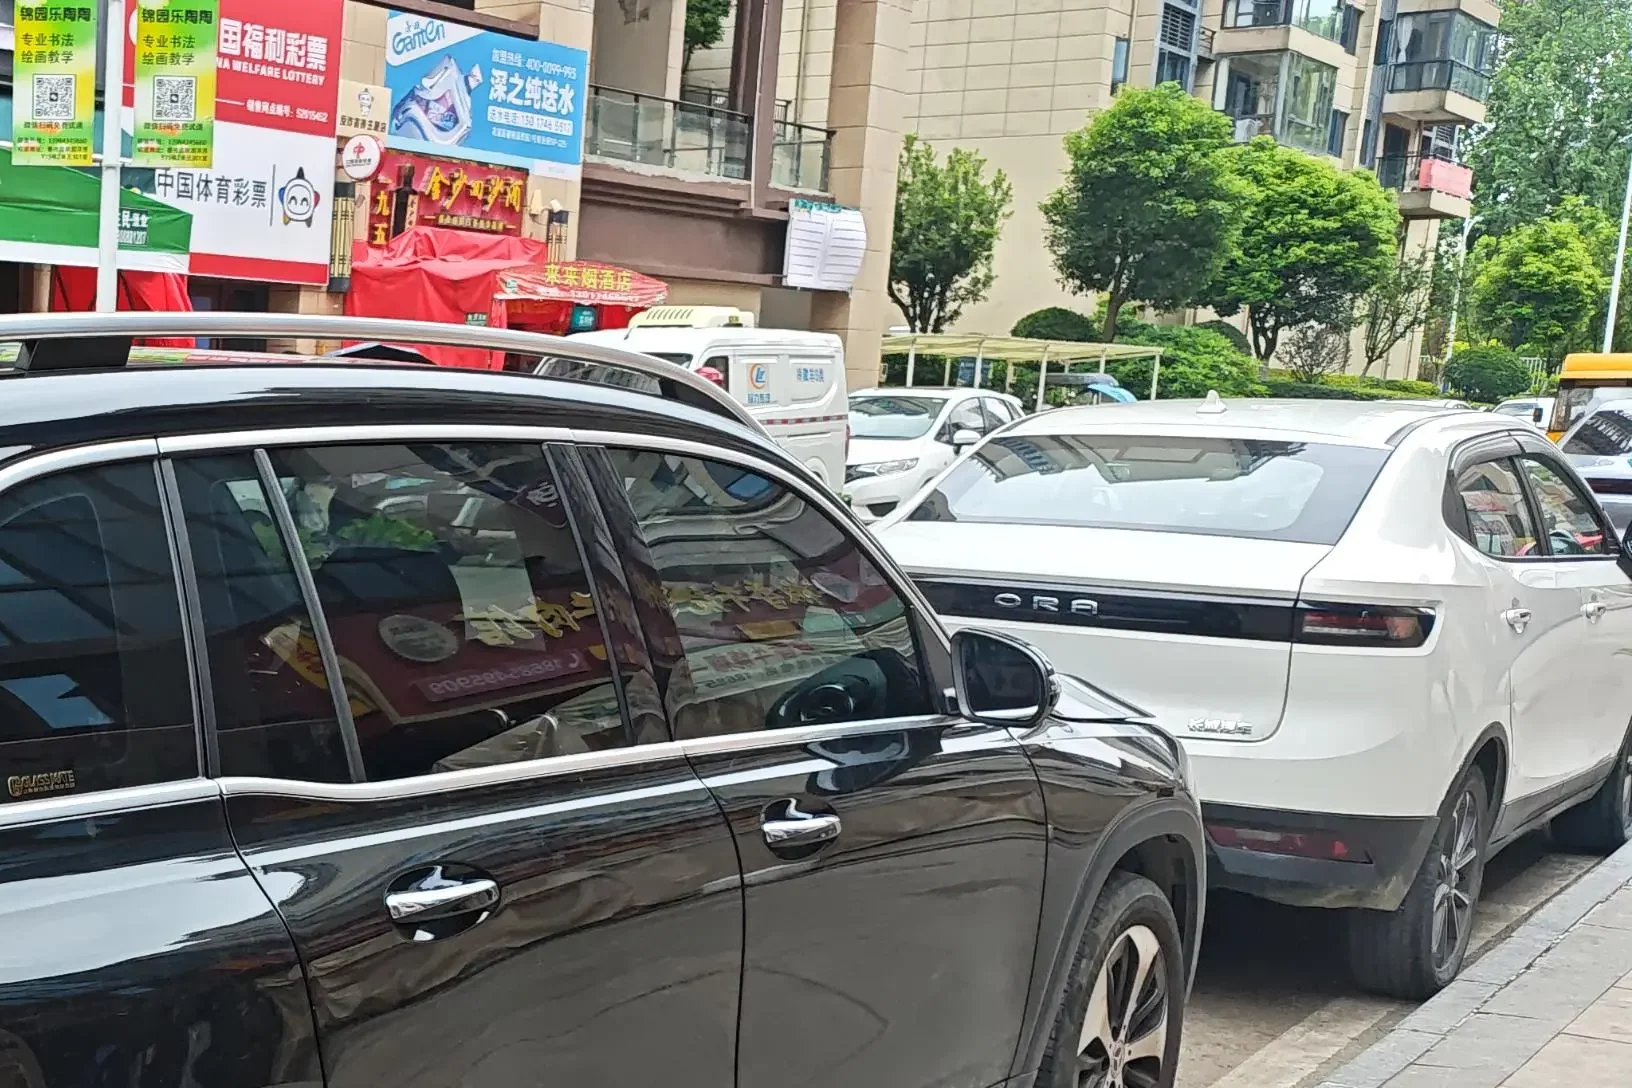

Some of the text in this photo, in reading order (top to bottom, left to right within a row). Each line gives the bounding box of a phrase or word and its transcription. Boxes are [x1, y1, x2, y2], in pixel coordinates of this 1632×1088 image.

[21, 33, 74, 47] 专业书法
[142, 34, 196, 49] 专业书法
[21, 50, 74, 64] 绘画教学
[142, 51, 196, 66] 绘画教学
[231, 59, 281, 79] WELFARE
[282, 69, 325, 86] LOTTERY
[157, 169, 268, 209] 中国体育彩票
[993, 592, 1099, 617] ORA
